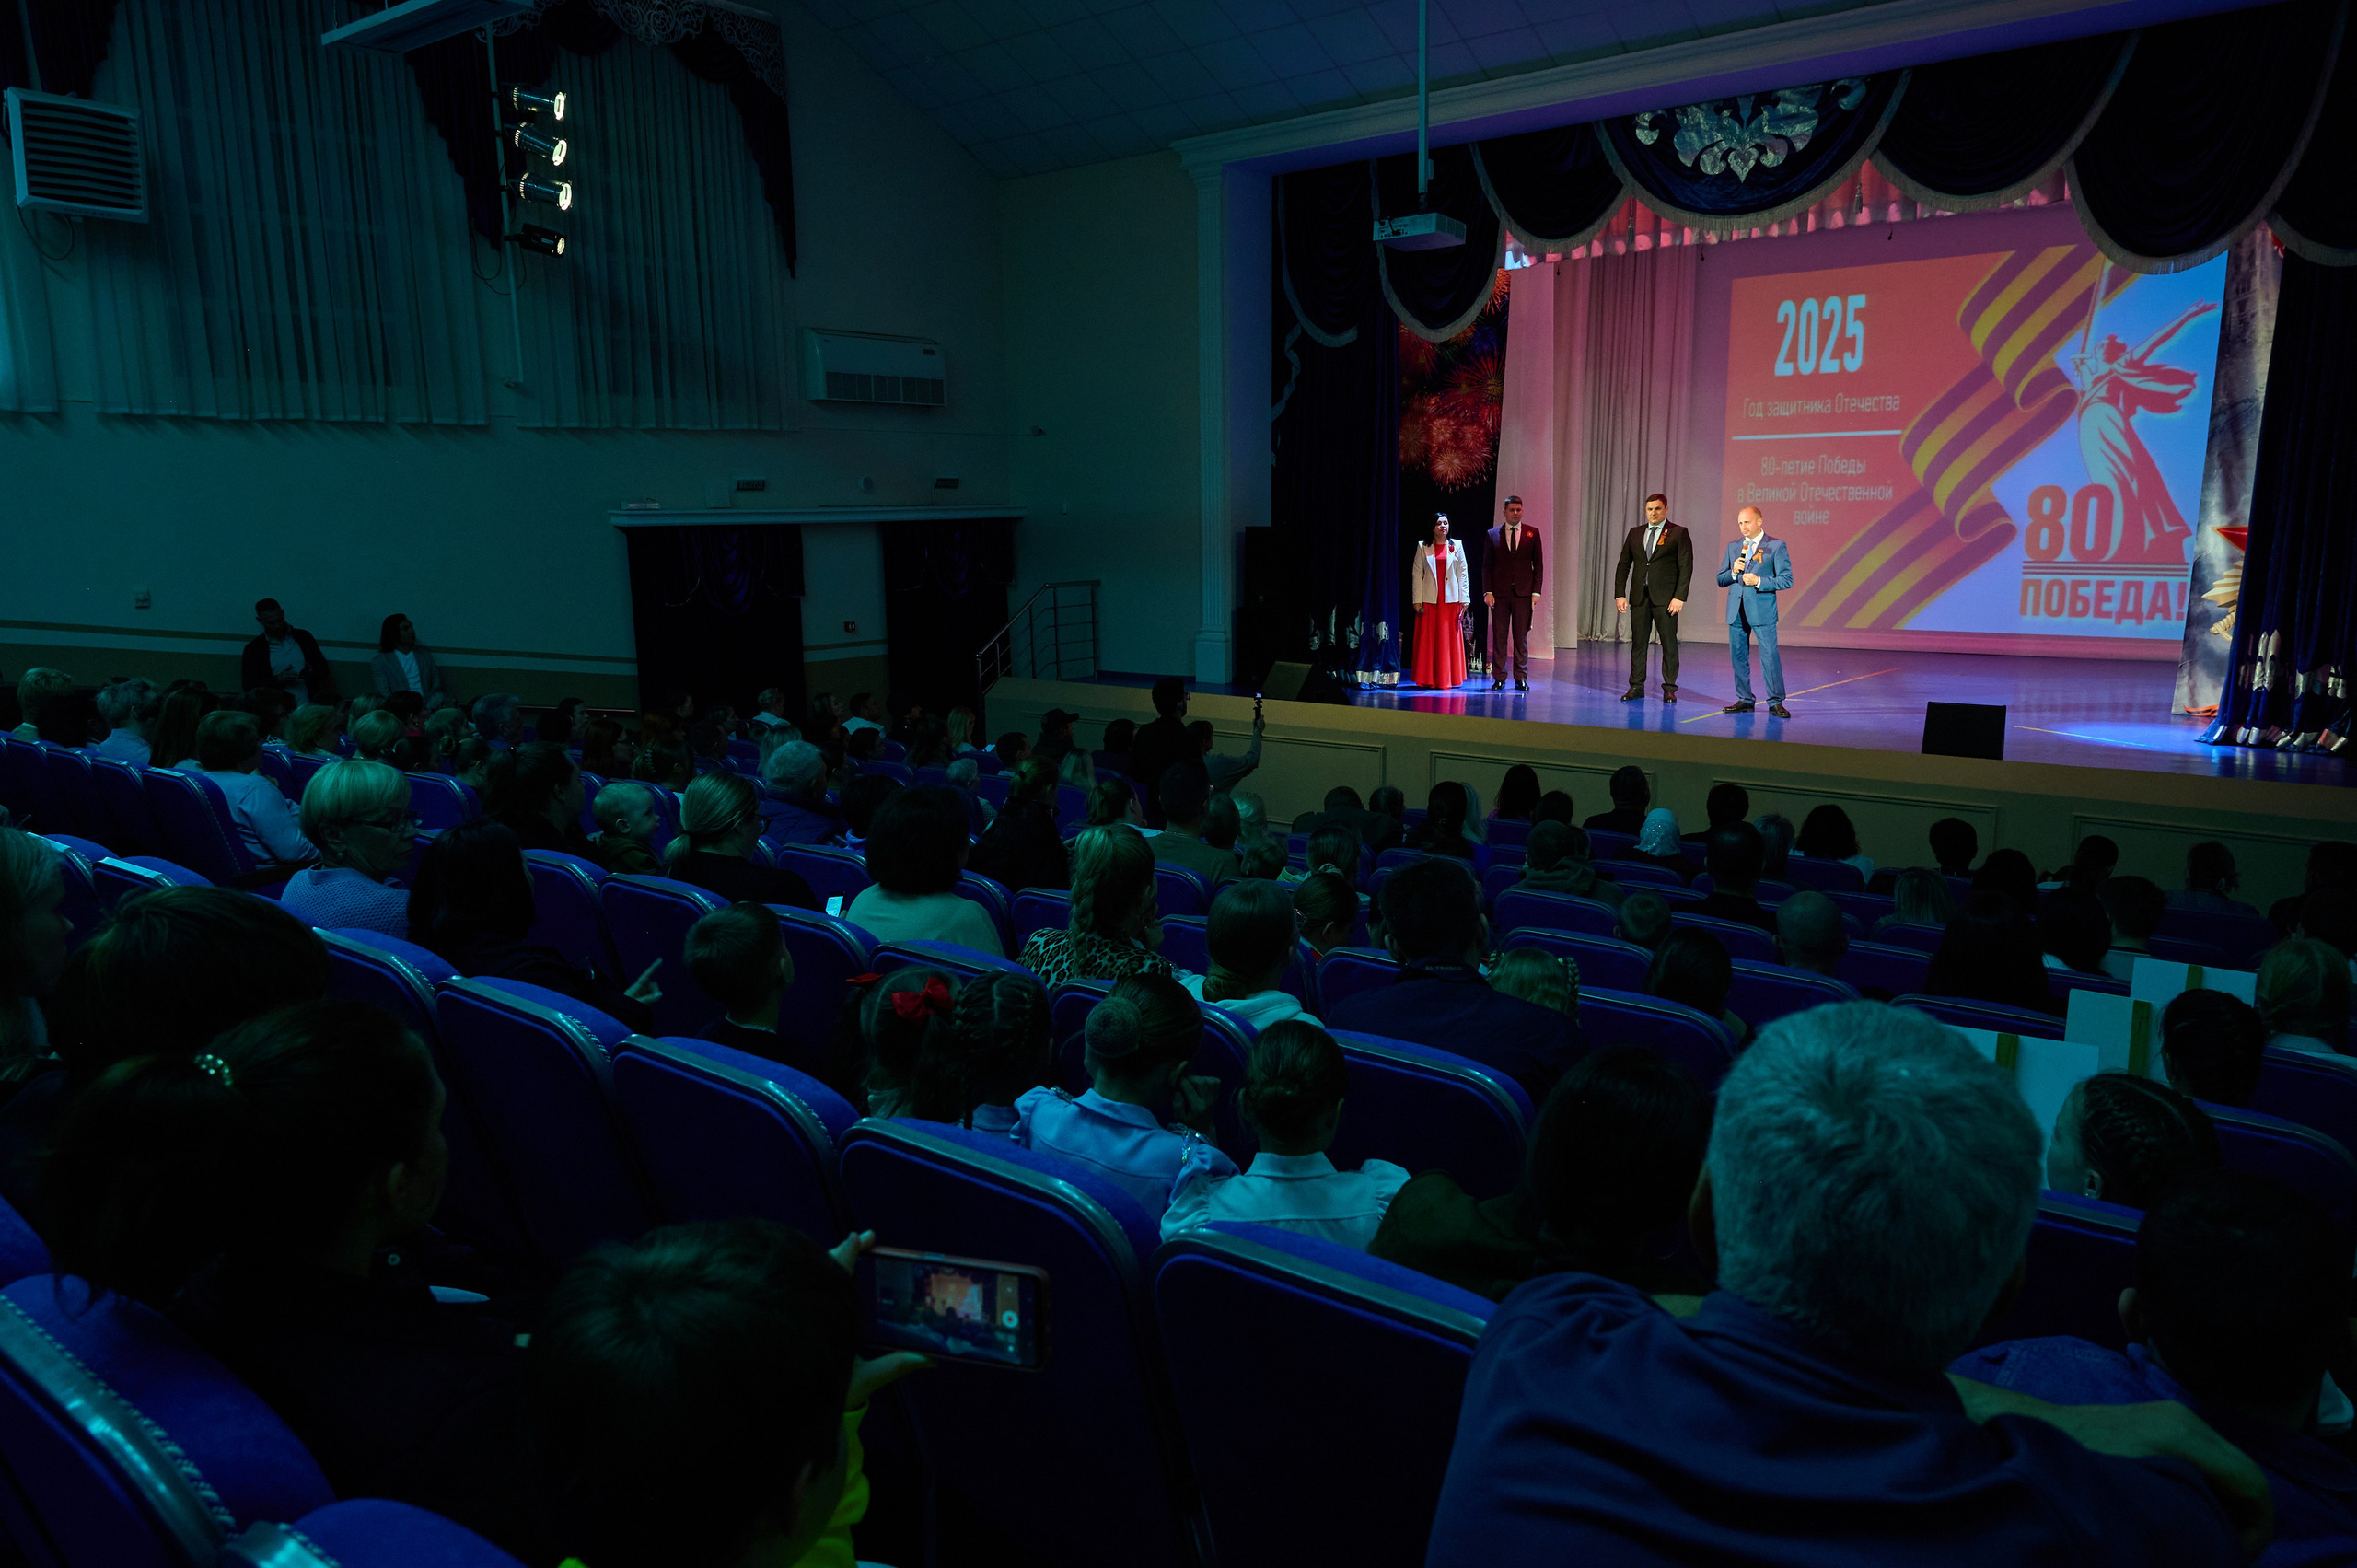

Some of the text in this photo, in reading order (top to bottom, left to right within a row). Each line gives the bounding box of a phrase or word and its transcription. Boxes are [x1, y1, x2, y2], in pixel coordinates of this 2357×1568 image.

[1774, 294, 1866, 377] 2025
[1743, 392, 1900, 418] Год защитника Отечества
[1760, 455, 1865, 476] 80-летие Победы
[1737, 481, 1893, 504] в Великой Отечественной
[1794, 505, 1829, 525] войне
[2025, 483, 2115, 562] 80
[2020, 578, 2188, 626] ПОБЕДА!
